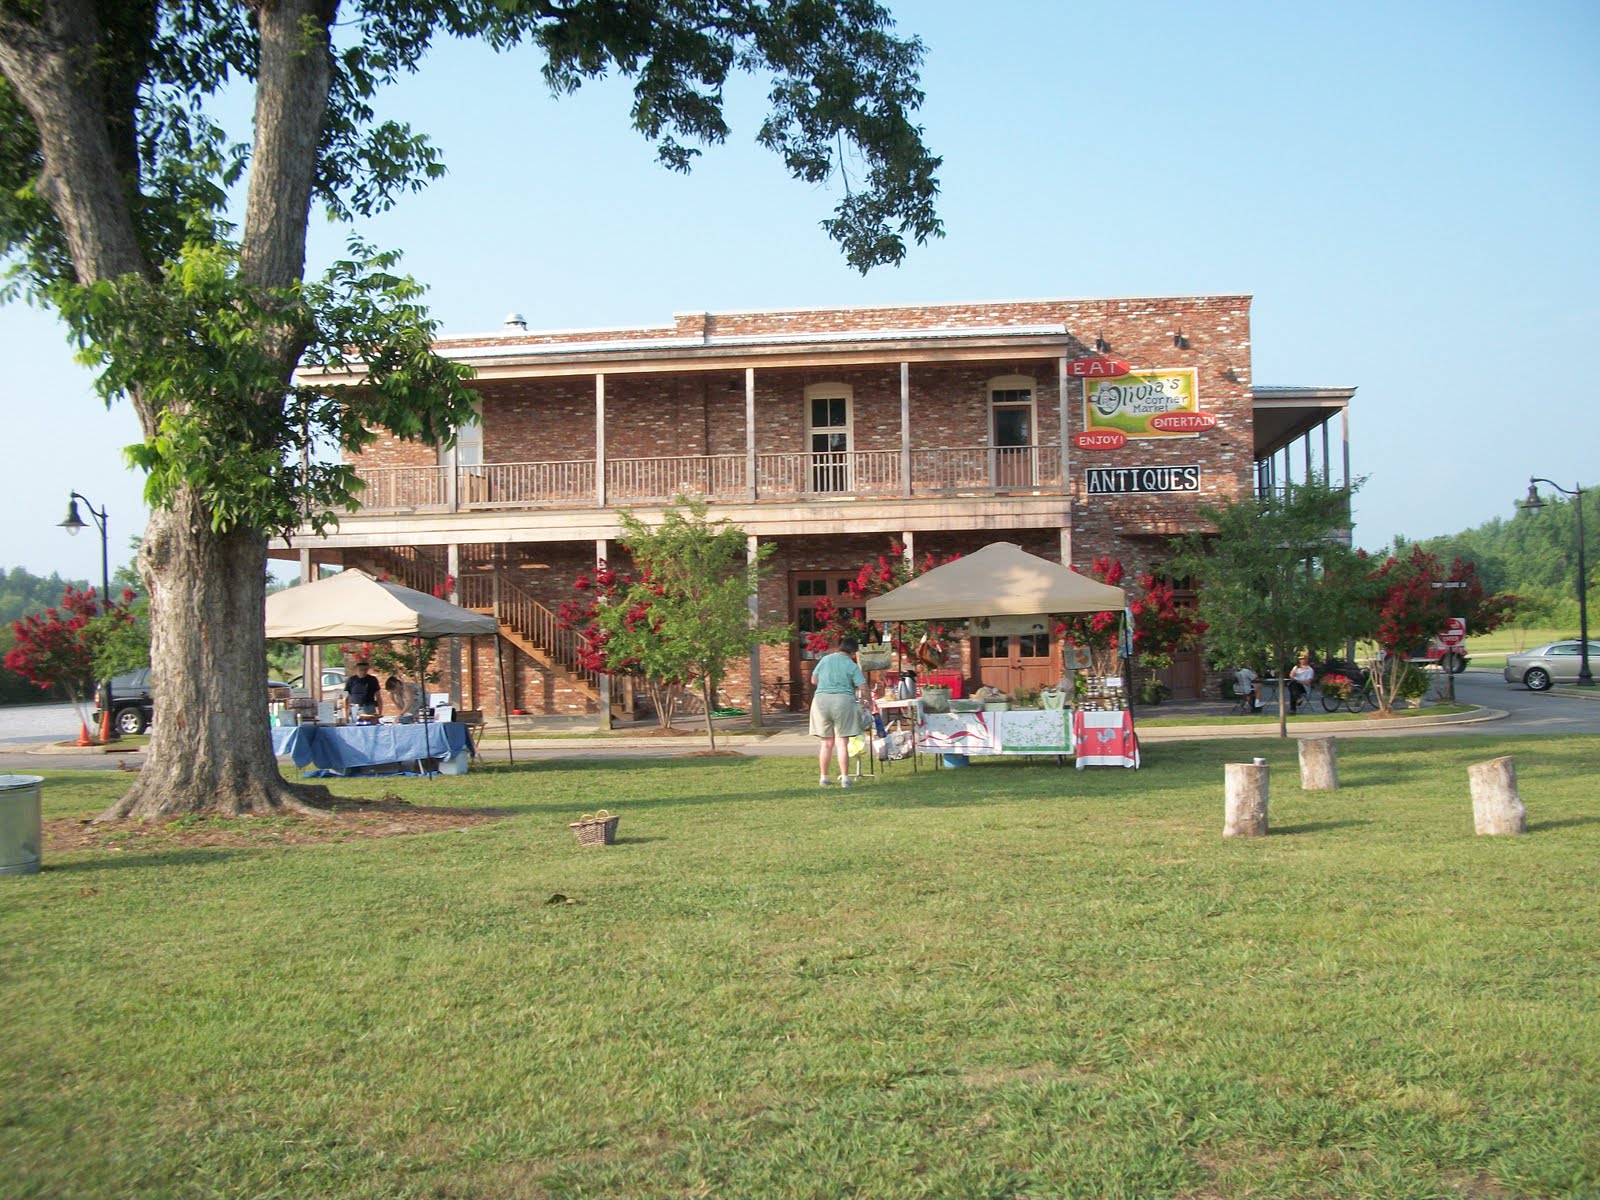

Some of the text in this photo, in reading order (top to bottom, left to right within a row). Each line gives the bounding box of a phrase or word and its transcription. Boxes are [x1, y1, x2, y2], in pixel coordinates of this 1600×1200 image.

[1073, 361, 1118, 375] EAT
[1096, 378, 1181, 416] Olivia's
[1132, 404, 1169, 414] Market
[1154, 416, 1215, 427] ENTERTAIN
[1079, 435, 1124, 446] ENJOY!
[1089, 468, 1198, 492] ANTIQUES
